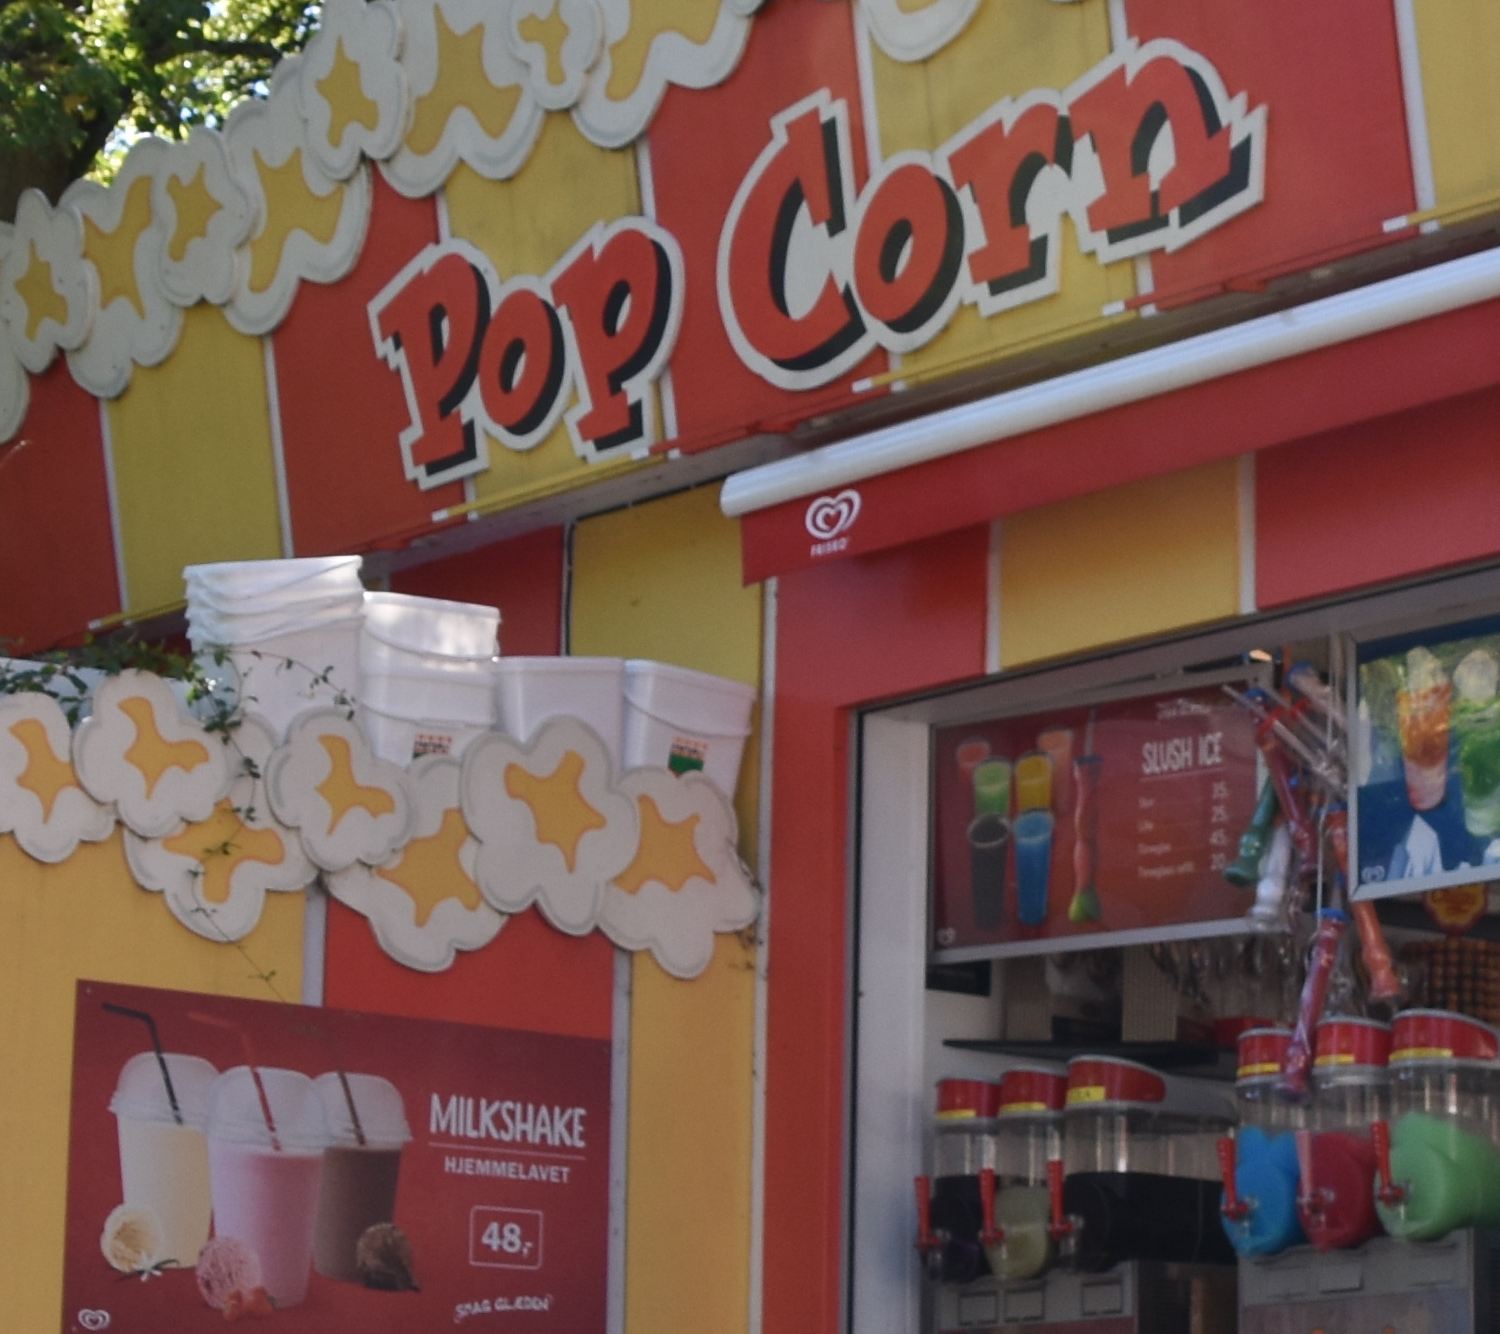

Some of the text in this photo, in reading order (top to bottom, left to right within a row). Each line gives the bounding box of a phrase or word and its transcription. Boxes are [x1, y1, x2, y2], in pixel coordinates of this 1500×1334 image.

[372, 45, 1262, 483] Pop Corn
[1143, 731, 1222, 775] SLUSH ICE
[429, 1092, 587, 1148] MILKSHAKE
[444, 1155, 571, 1184] HJEMMELAVET
[455, 1299, 491, 1317] SMAG
